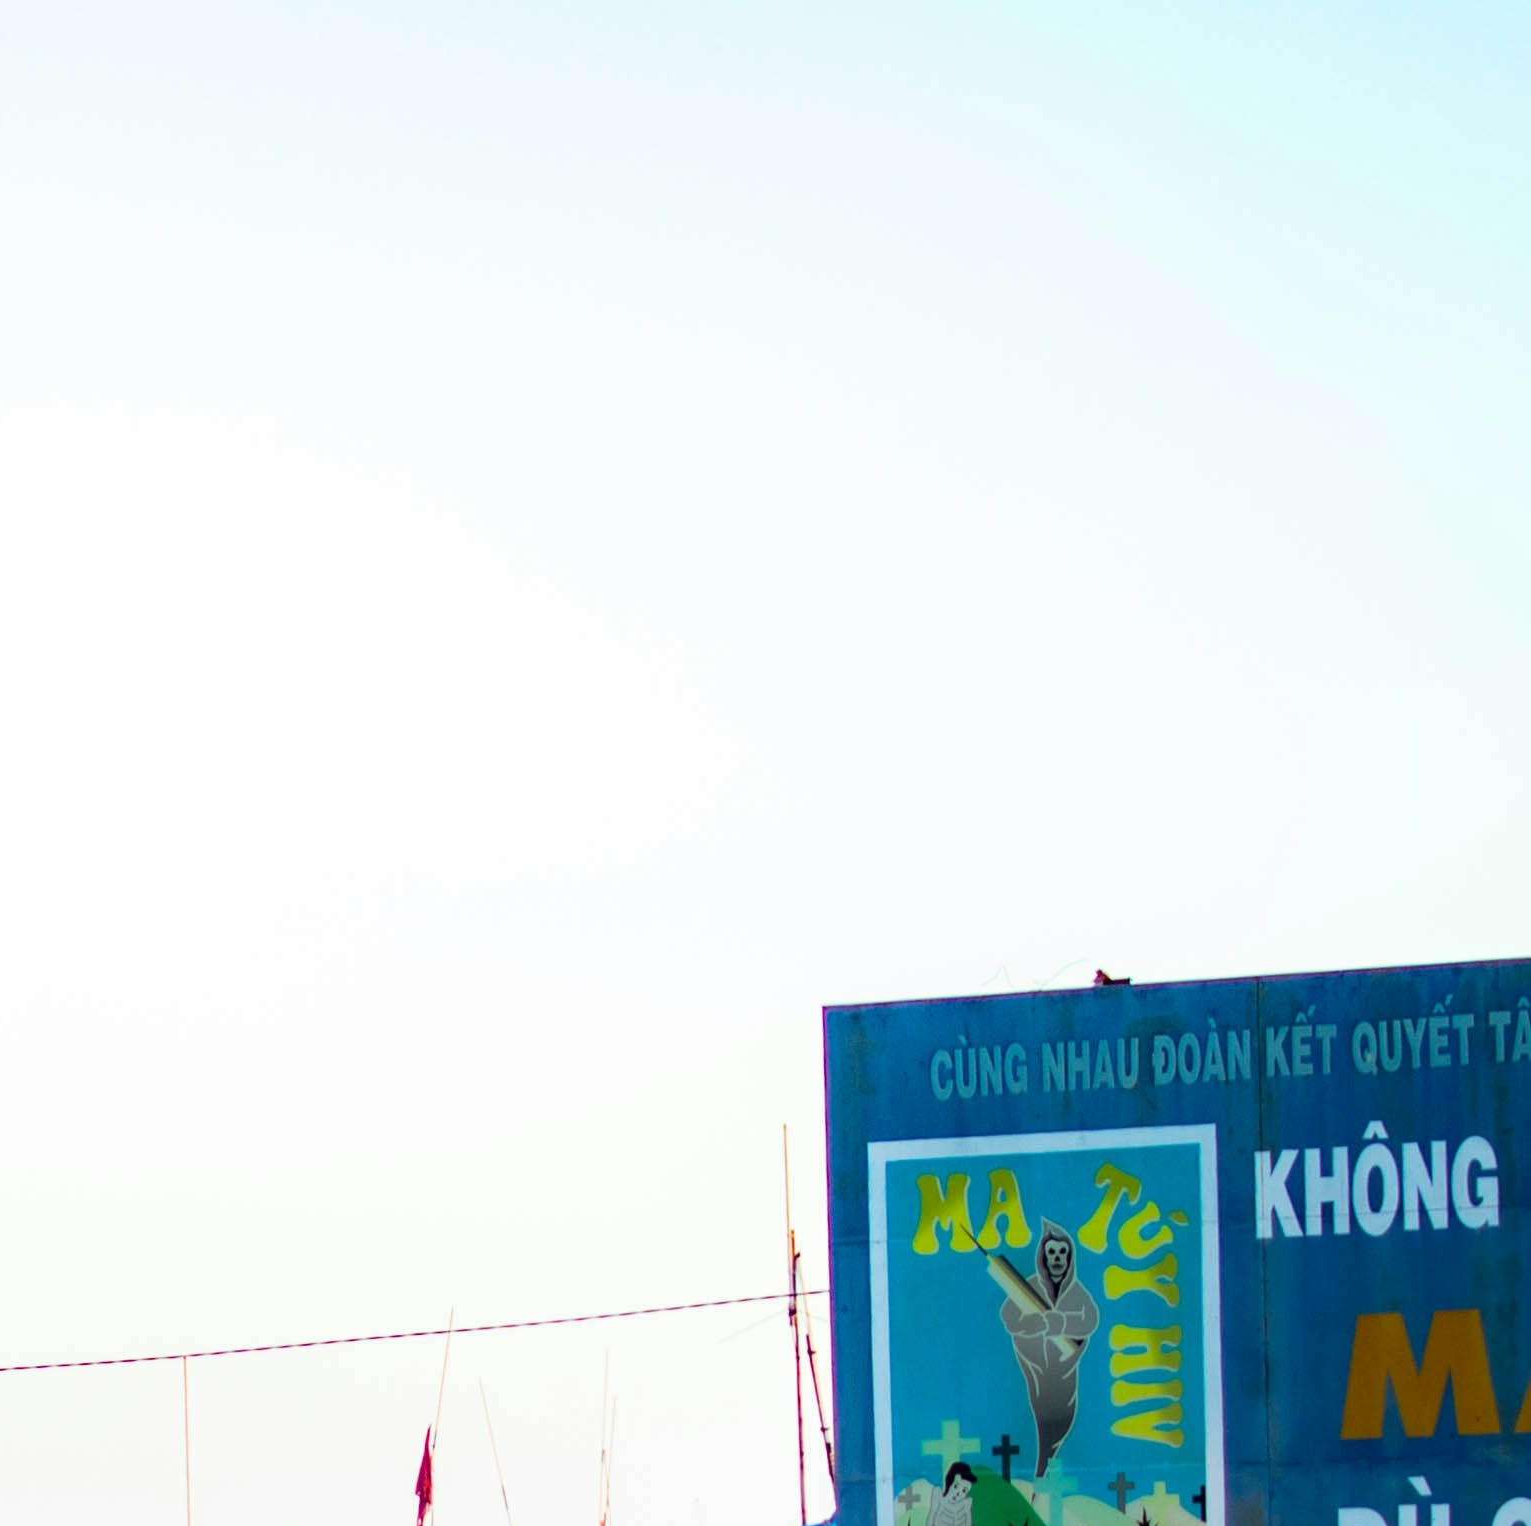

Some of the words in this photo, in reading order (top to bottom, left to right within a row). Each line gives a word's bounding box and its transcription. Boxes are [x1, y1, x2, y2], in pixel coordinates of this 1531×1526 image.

[930, 1035, 1029, 1101] CÙNG
[1042, 1036, 1139, 1093] NHAU
[1152, 1017, 1252, 1087] ĐOÀN
[1265, 1004, 1338, 1077] KẾT
[1351, 994, 1475, 1076] QUYẾT
[1253, 1120, 1500, 1240] KHÔNG
[912, 1168, 1032, 1256] MA
[1109, 1324, 1185, 1449] HIV
[1340, 1309, 1531, 1440] M
